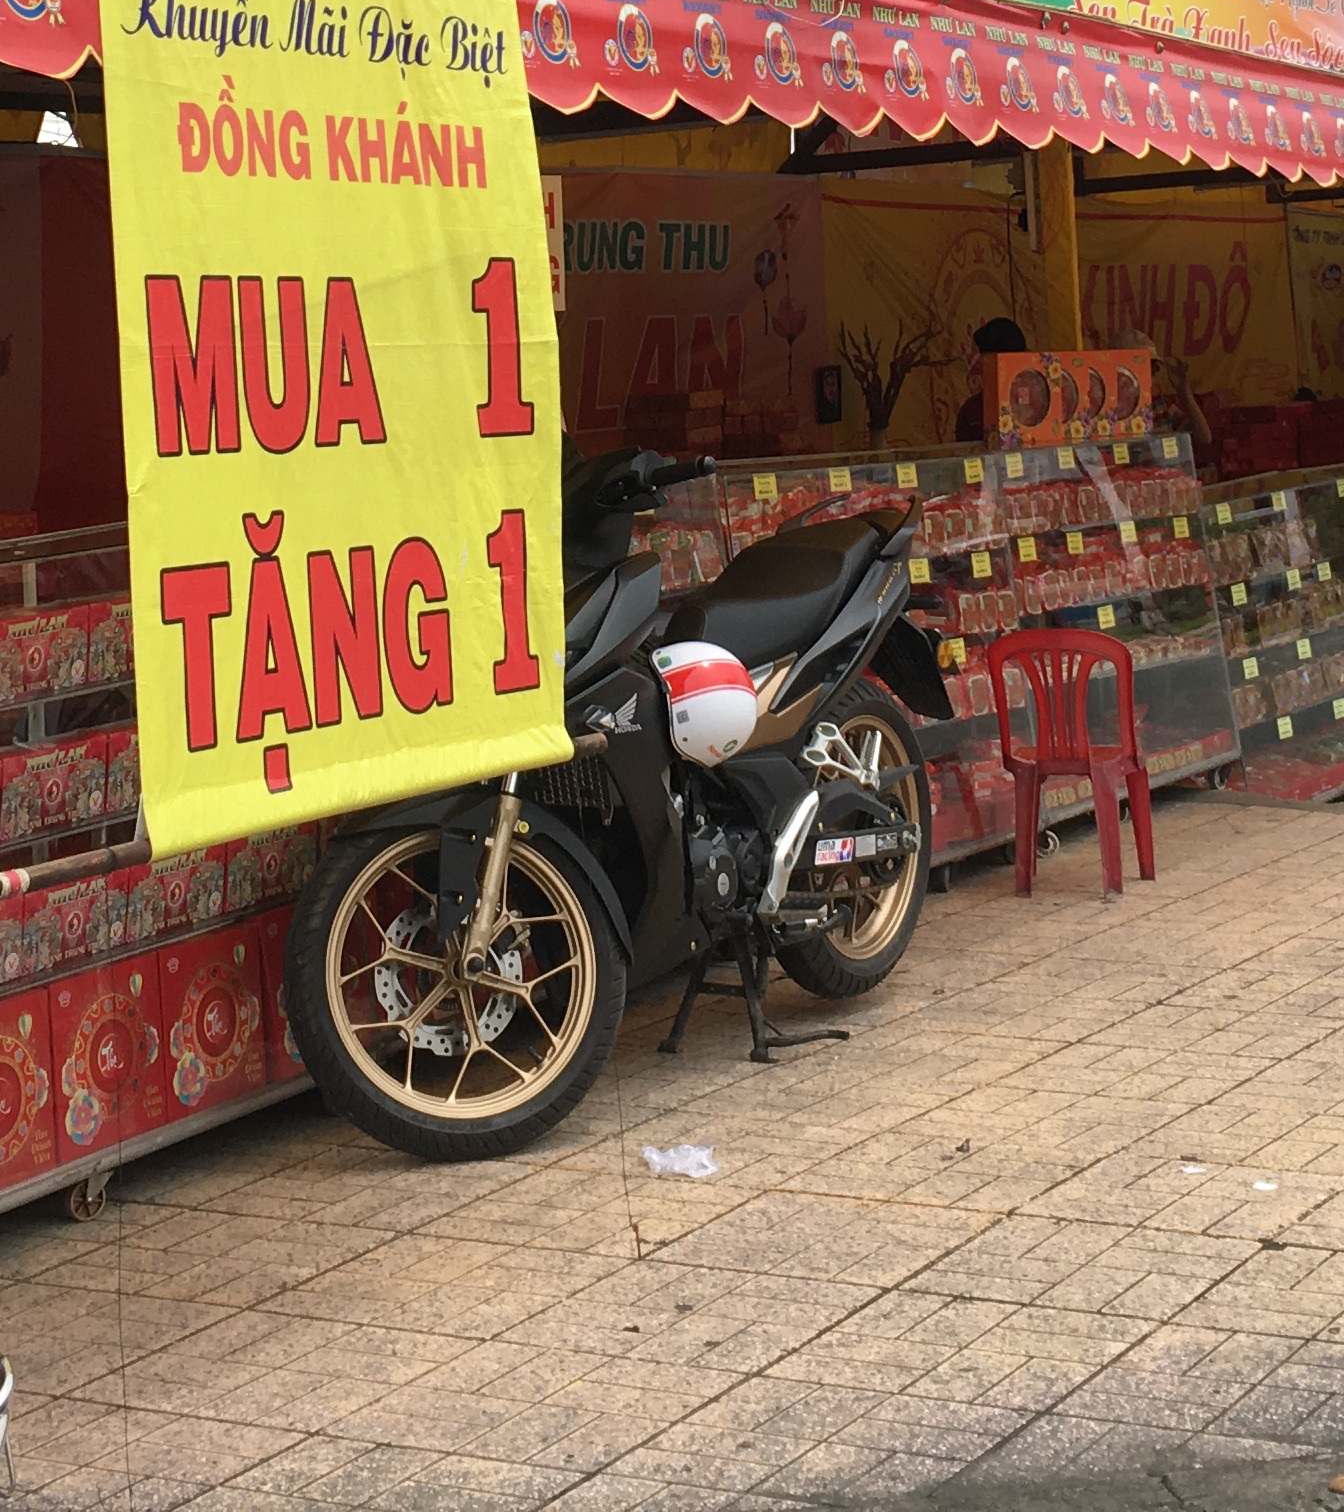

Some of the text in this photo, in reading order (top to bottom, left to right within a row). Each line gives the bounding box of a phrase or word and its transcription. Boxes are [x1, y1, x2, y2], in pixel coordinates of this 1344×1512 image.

[358, 5, 431, 81] Đặc
[440, 15, 509, 88] Biệt
[176, 75, 488, 190] ĐỒNG KHÁNH
[563, 220, 646, 273] RUNG
[658, 222, 731, 272] THU
[144, 257, 535, 457] MUA 1
[159, 508, 542, 794] TẶNG 1
[614, 723, 643, 735] HONDA
[816, 849, 841, 863] racing
[817, 838, 837, 852] uma
